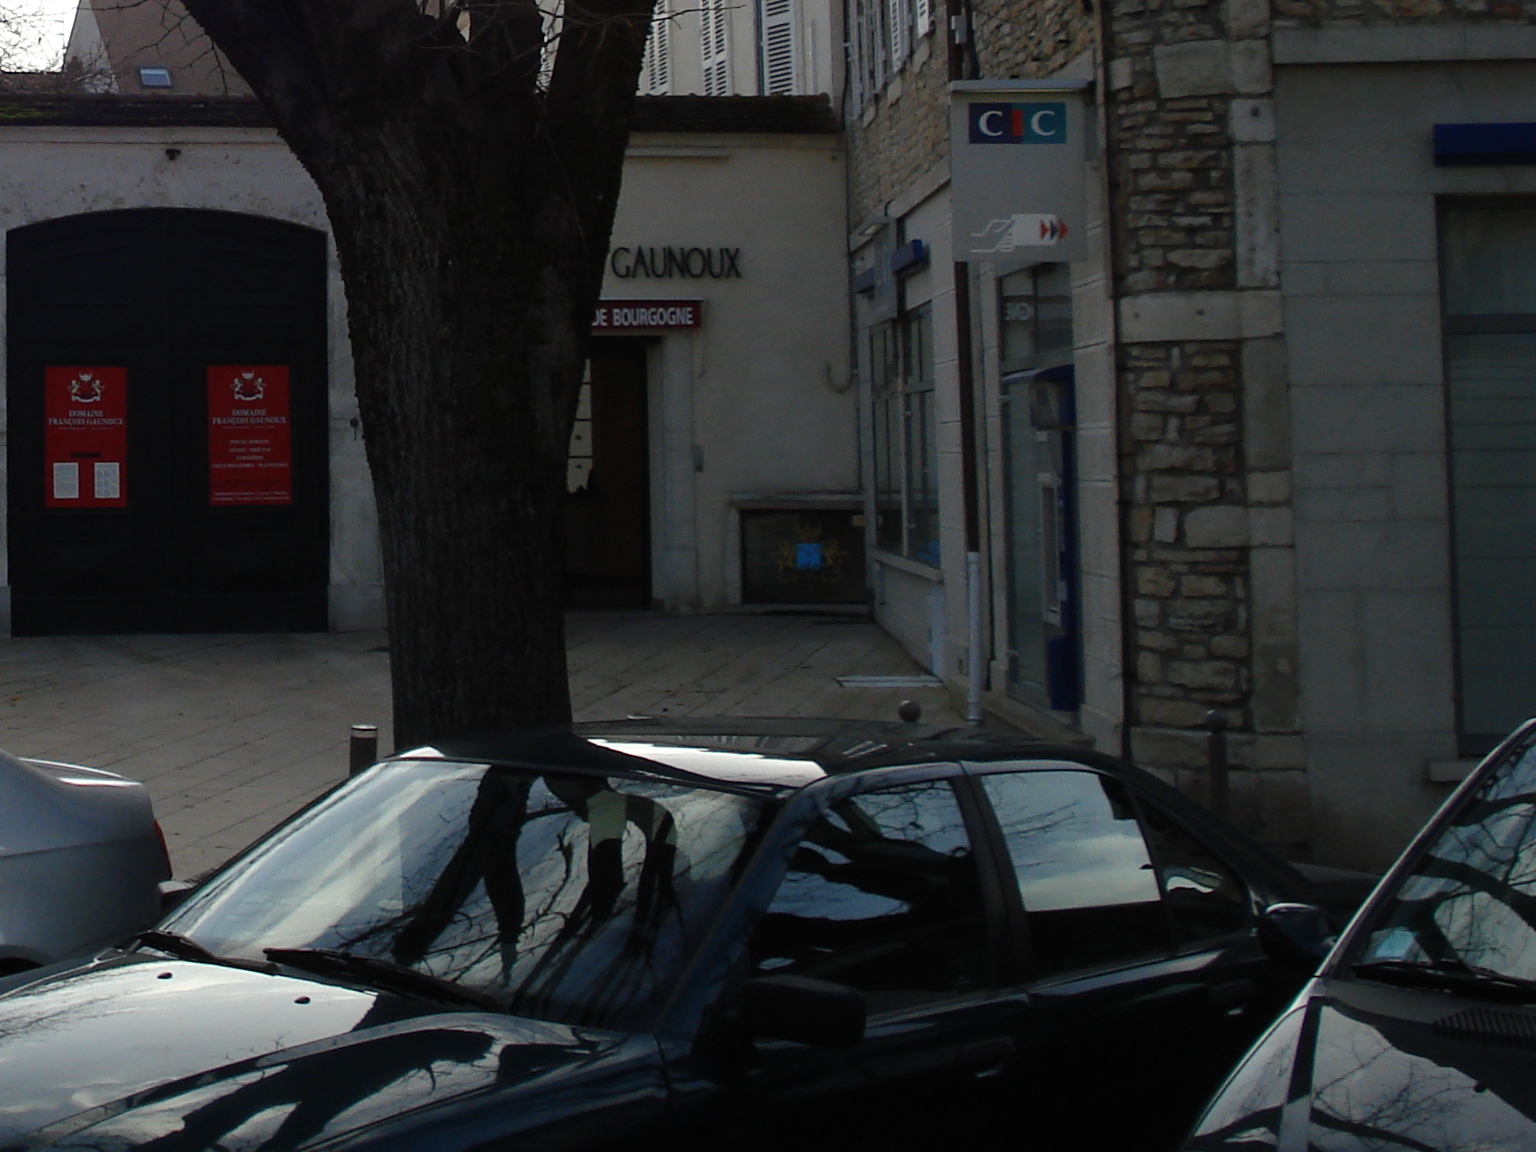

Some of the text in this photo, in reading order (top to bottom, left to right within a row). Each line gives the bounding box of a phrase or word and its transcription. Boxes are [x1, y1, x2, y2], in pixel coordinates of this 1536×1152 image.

[978, 109, 1056, 137] CIC
[611, 245, 743, 279] GAUNOUX
[612, 307, 694, 326] BOURGOGNE
[68, 410, 104, 418] DOMAINE
[86, 417, 124, 426] GAUNOUX
